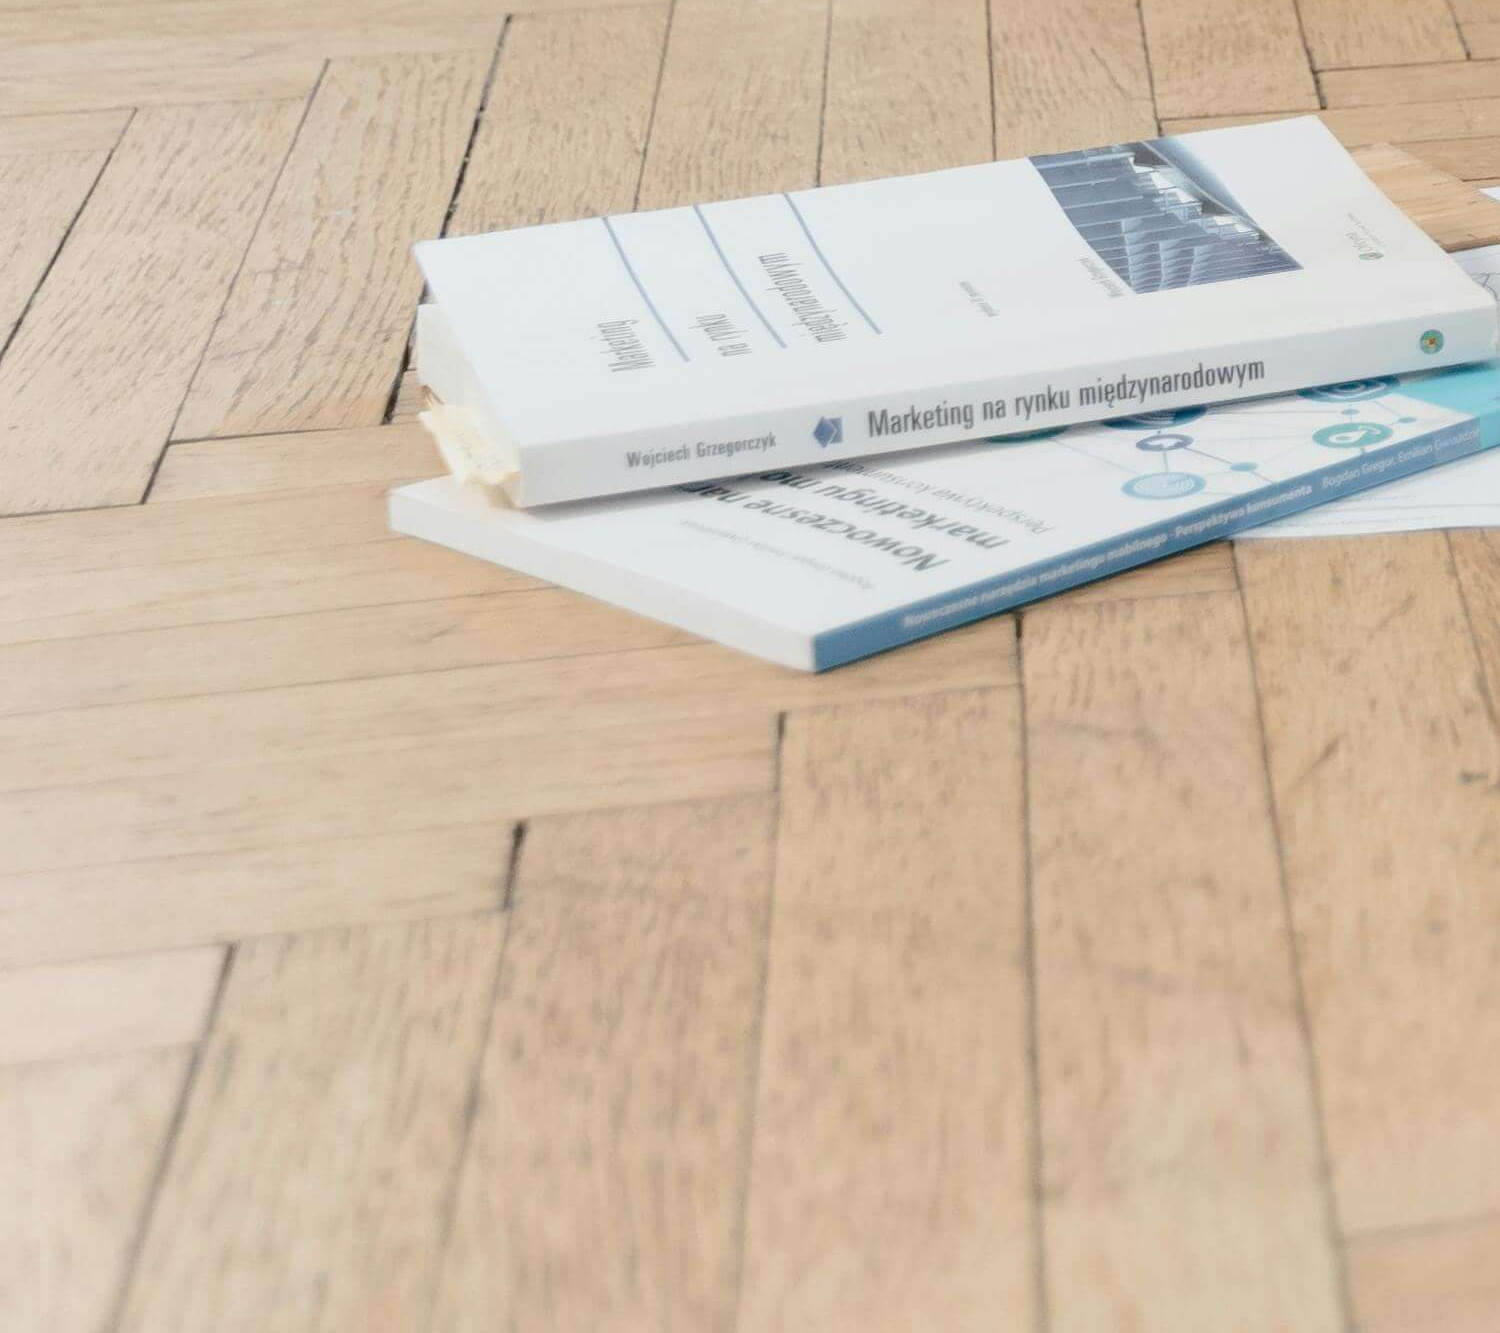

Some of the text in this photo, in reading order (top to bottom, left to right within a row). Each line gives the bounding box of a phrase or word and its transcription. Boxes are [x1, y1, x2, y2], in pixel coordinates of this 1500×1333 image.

[758, 253, 847, 343] międzynarodowym
[590, 319, 657, 373] Marketing
[688, 313, 752, 358] na rynku
[868, 360, 1265, 437] Marketing na rynku międzynarodowym
[626, 432, 776, 469] Wojciech Grzegorczyk
[742, 499, 950, 571] Nowoczesne
[812, 484, 1010, 549] marketingu
